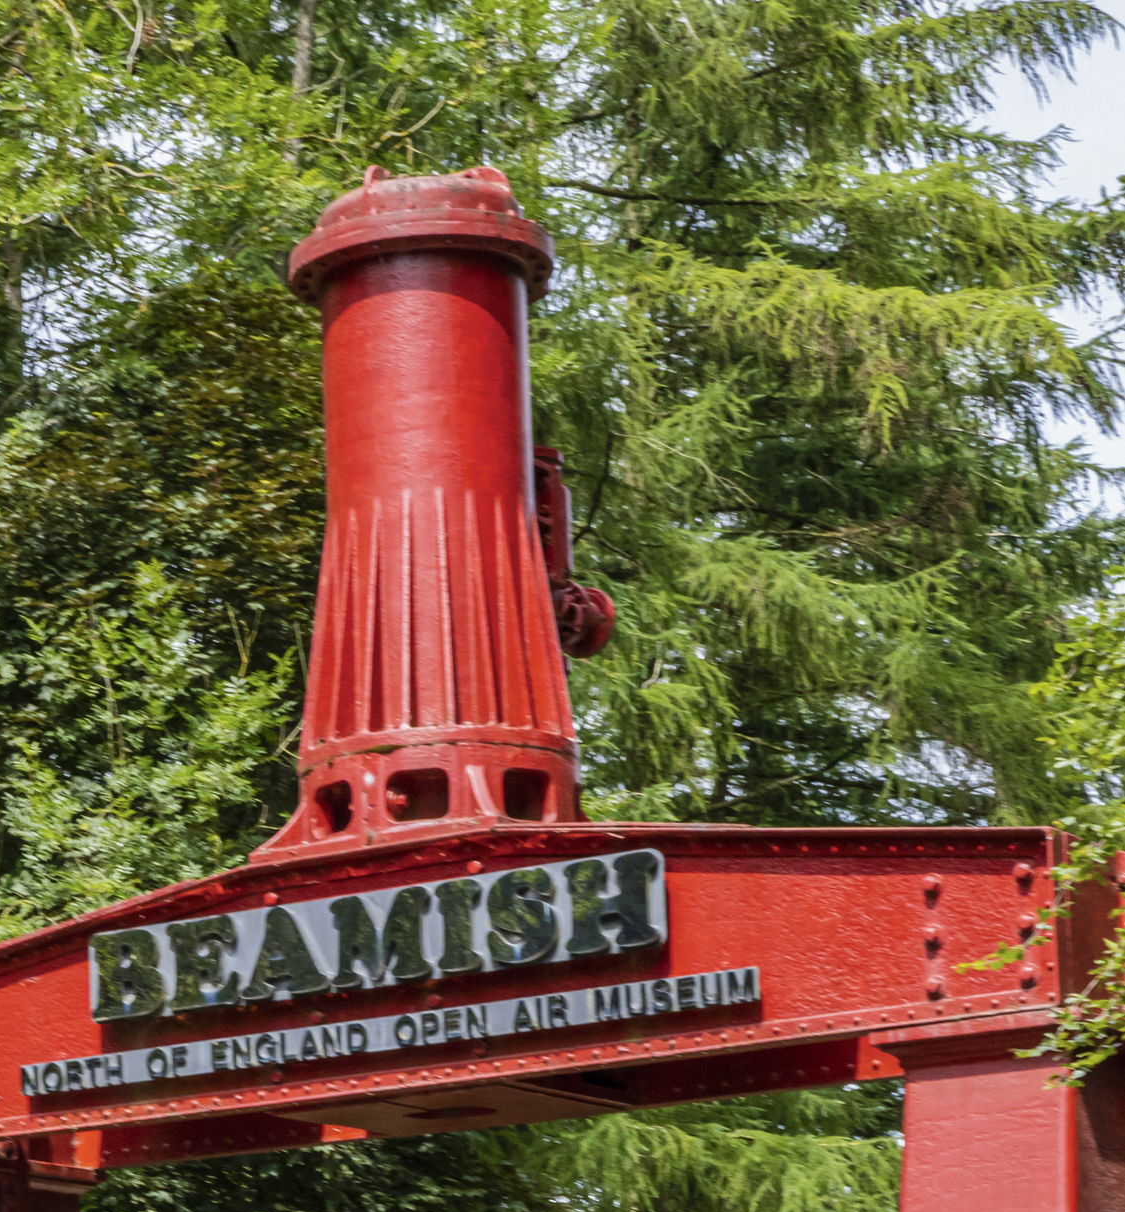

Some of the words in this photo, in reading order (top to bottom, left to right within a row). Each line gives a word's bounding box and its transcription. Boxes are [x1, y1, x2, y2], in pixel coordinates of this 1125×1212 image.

[93, 850, 663, 1023] BEAMISH
[21, 1055, 124, 1096] NORTH
[147, 1046, 188, 1078] OF
[211, 1022, 369, 1070] ENGLAND
[395, 1004, 488, 1047] OPEN
[514, 994, 570, 1033] AIR
[591, 967, 759, 1022] MUSEUM
